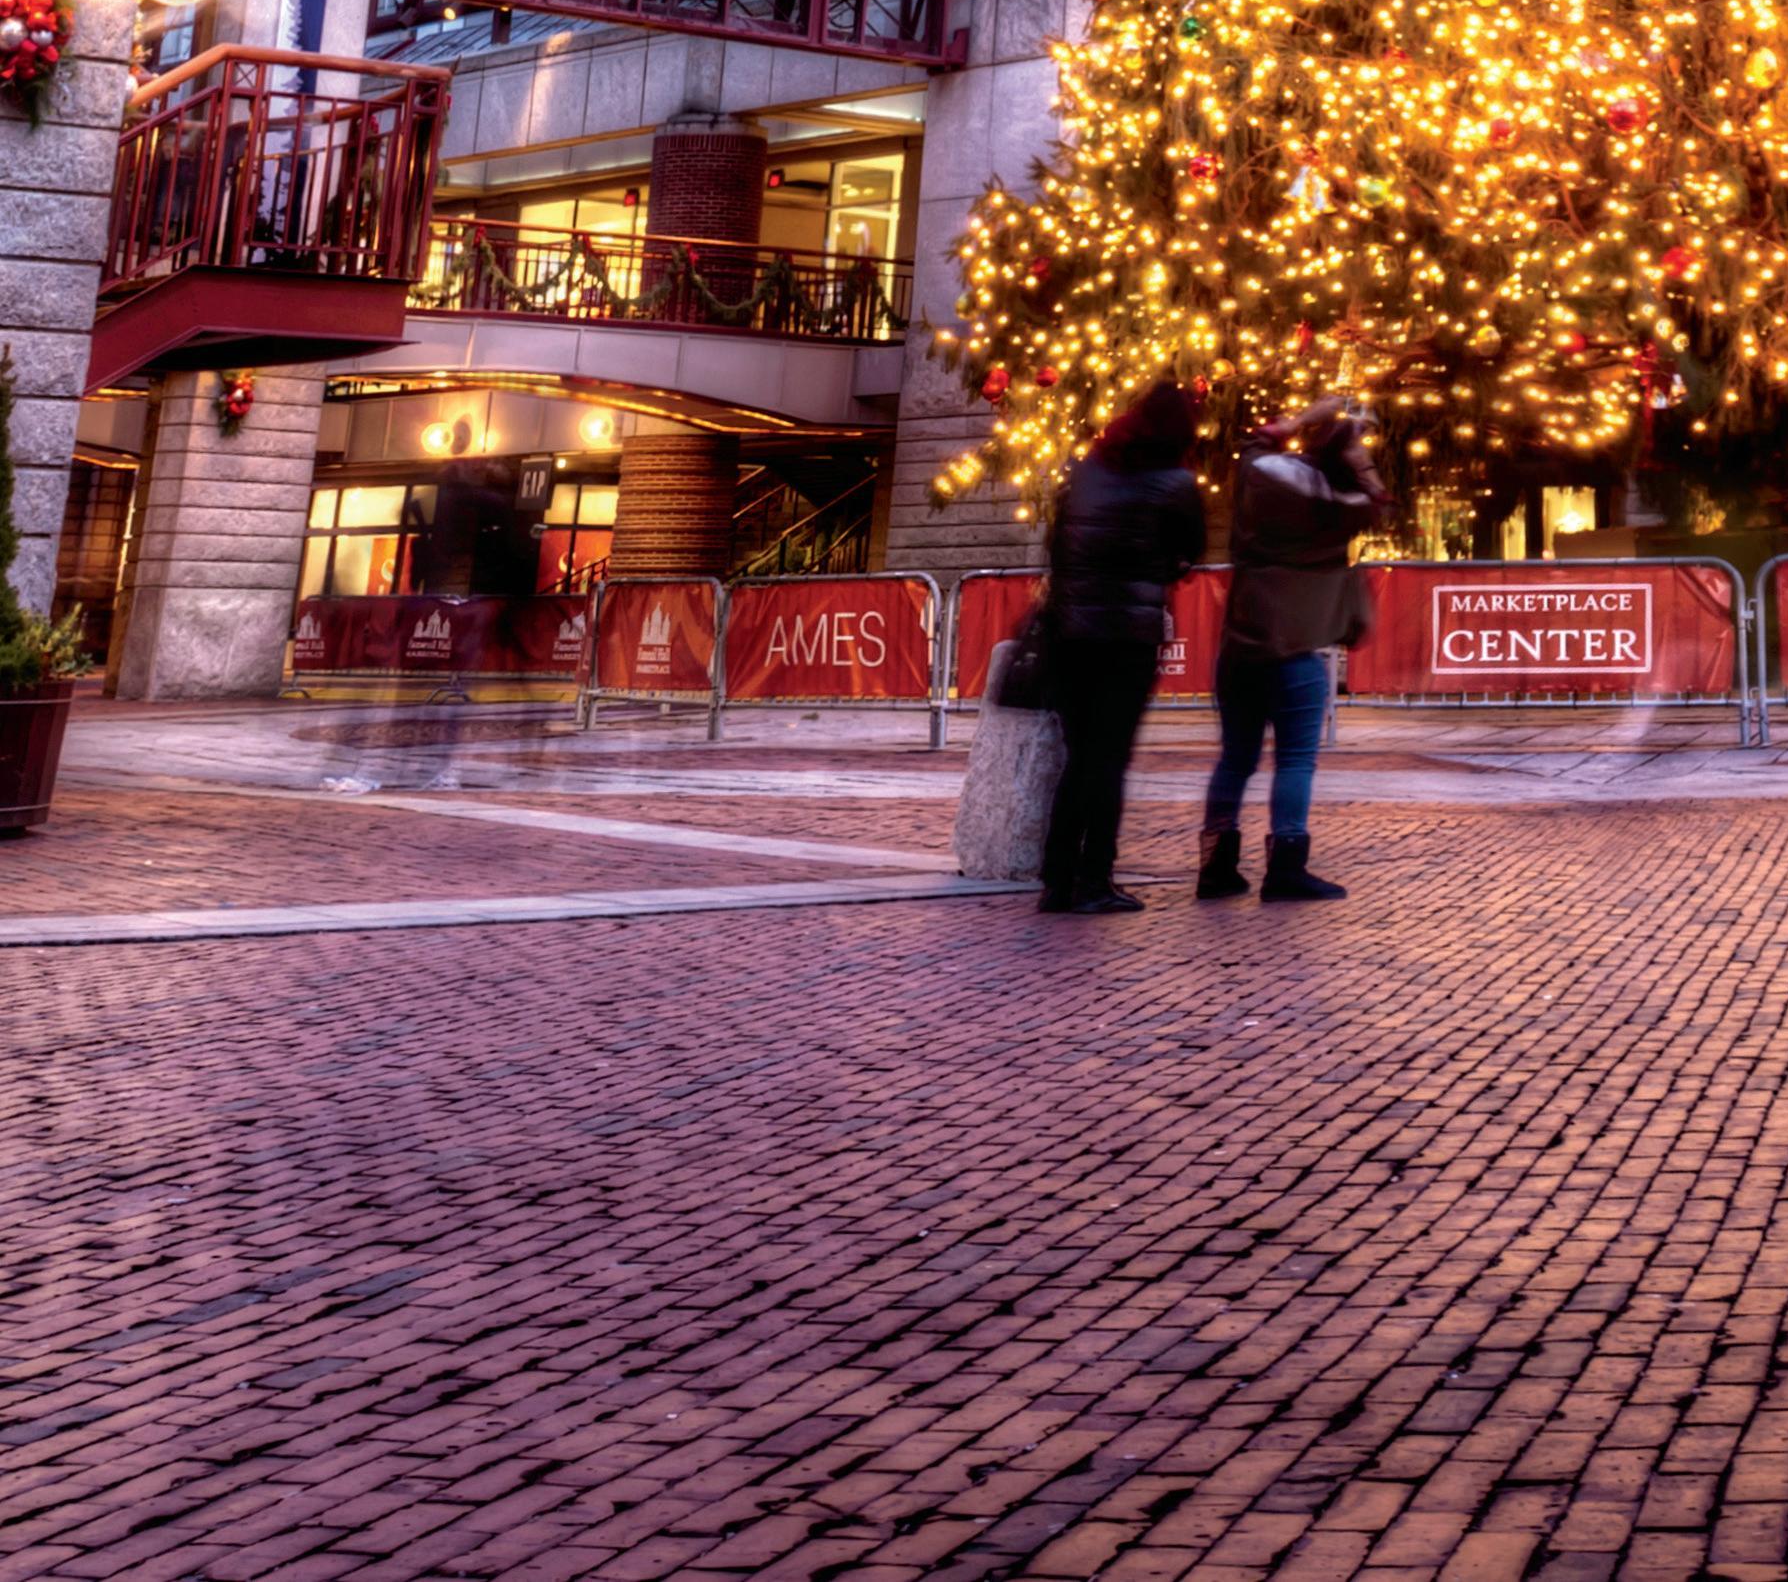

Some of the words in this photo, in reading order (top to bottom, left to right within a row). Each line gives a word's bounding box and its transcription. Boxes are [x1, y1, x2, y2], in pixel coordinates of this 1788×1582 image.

[521, 470, 546, 498] GAP
[1450, 593, 1633, 613] MARKETPLACE
[764, 610, 887, 668] AMES
[1442, 629, 1642, 663] CENTER
